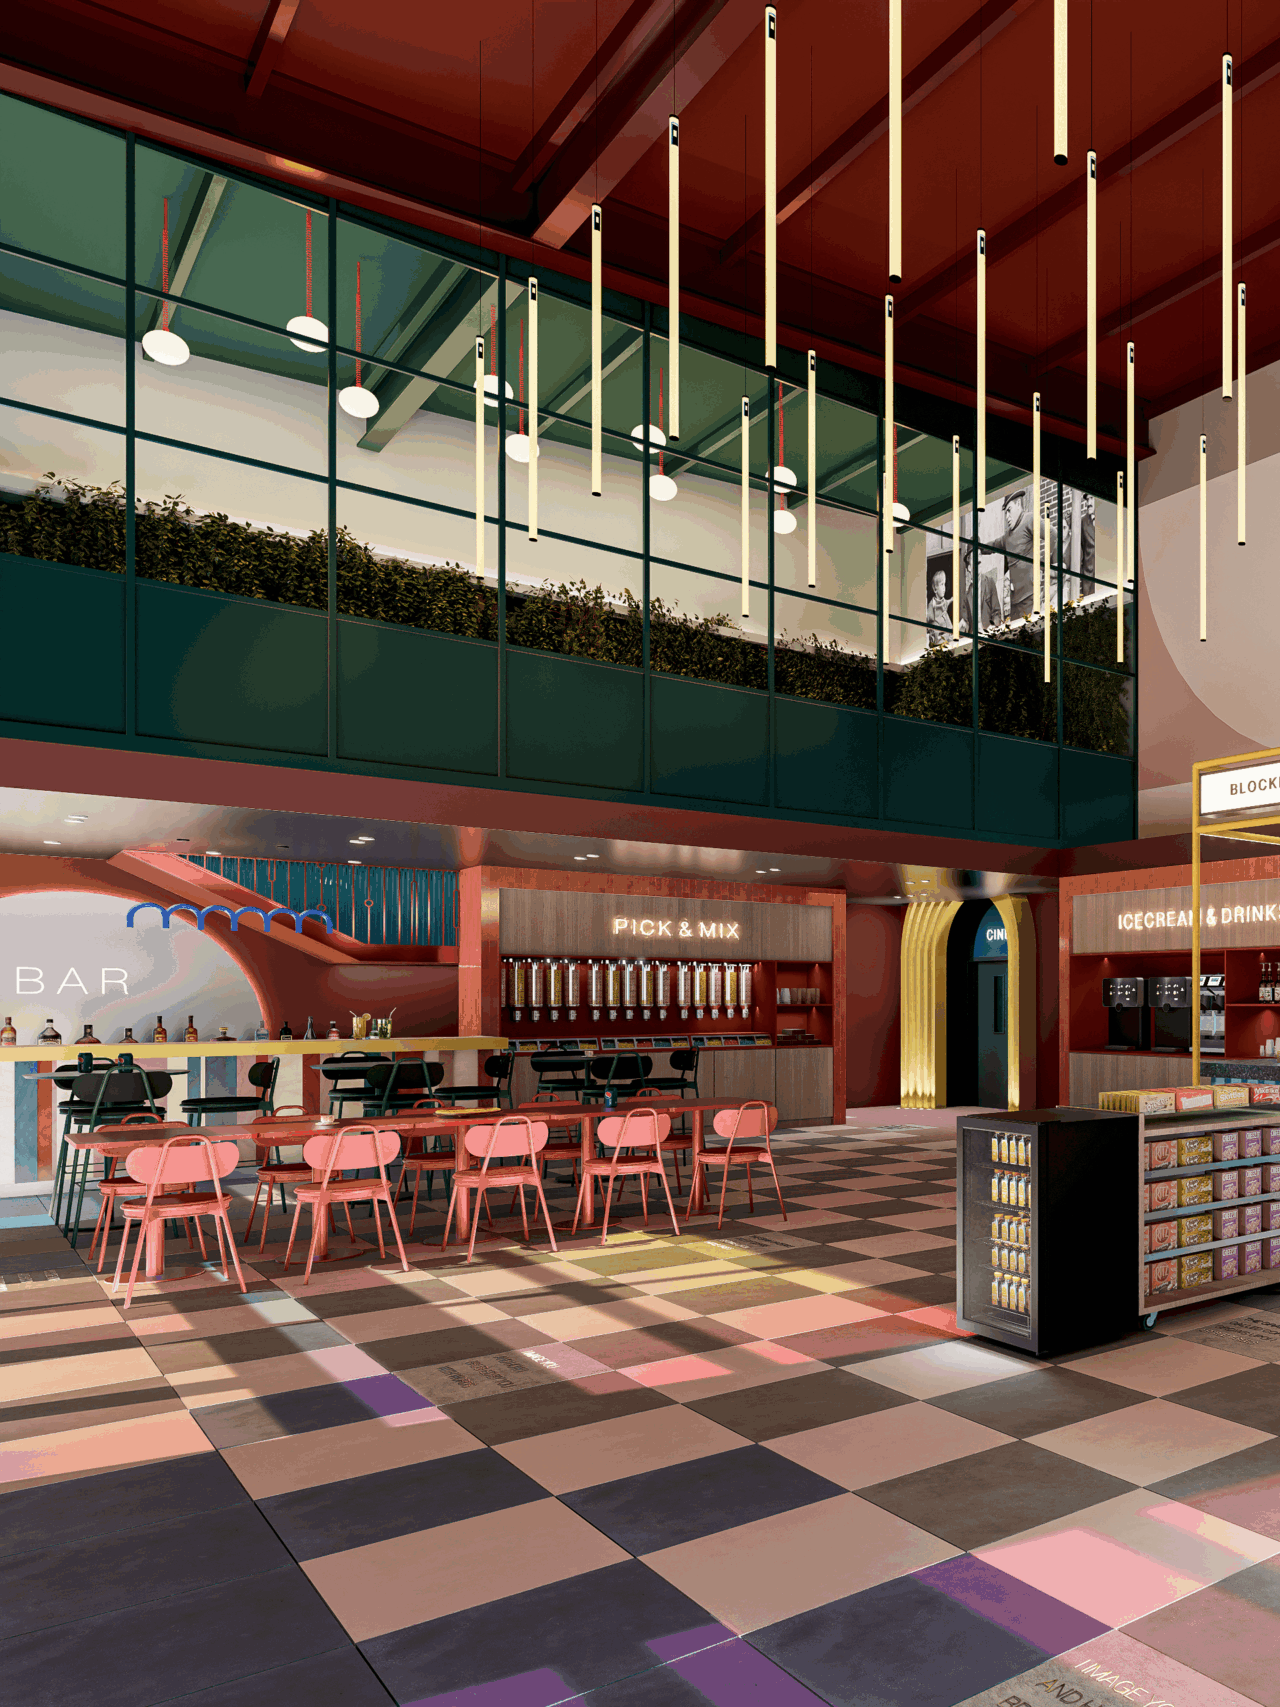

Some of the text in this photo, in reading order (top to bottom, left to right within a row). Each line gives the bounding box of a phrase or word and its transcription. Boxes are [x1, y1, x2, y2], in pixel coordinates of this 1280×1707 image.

[1205, 907, 1217, 926] &
[614, 918, 739, 940] PICK & MIX
[16, 966, 129, 995] BAR
[1219, 1091, 1245, 1102] Skittles
[1254, 1087, 1269, 1095] Mike
[1035, 1678, 1083, 1704] AND
